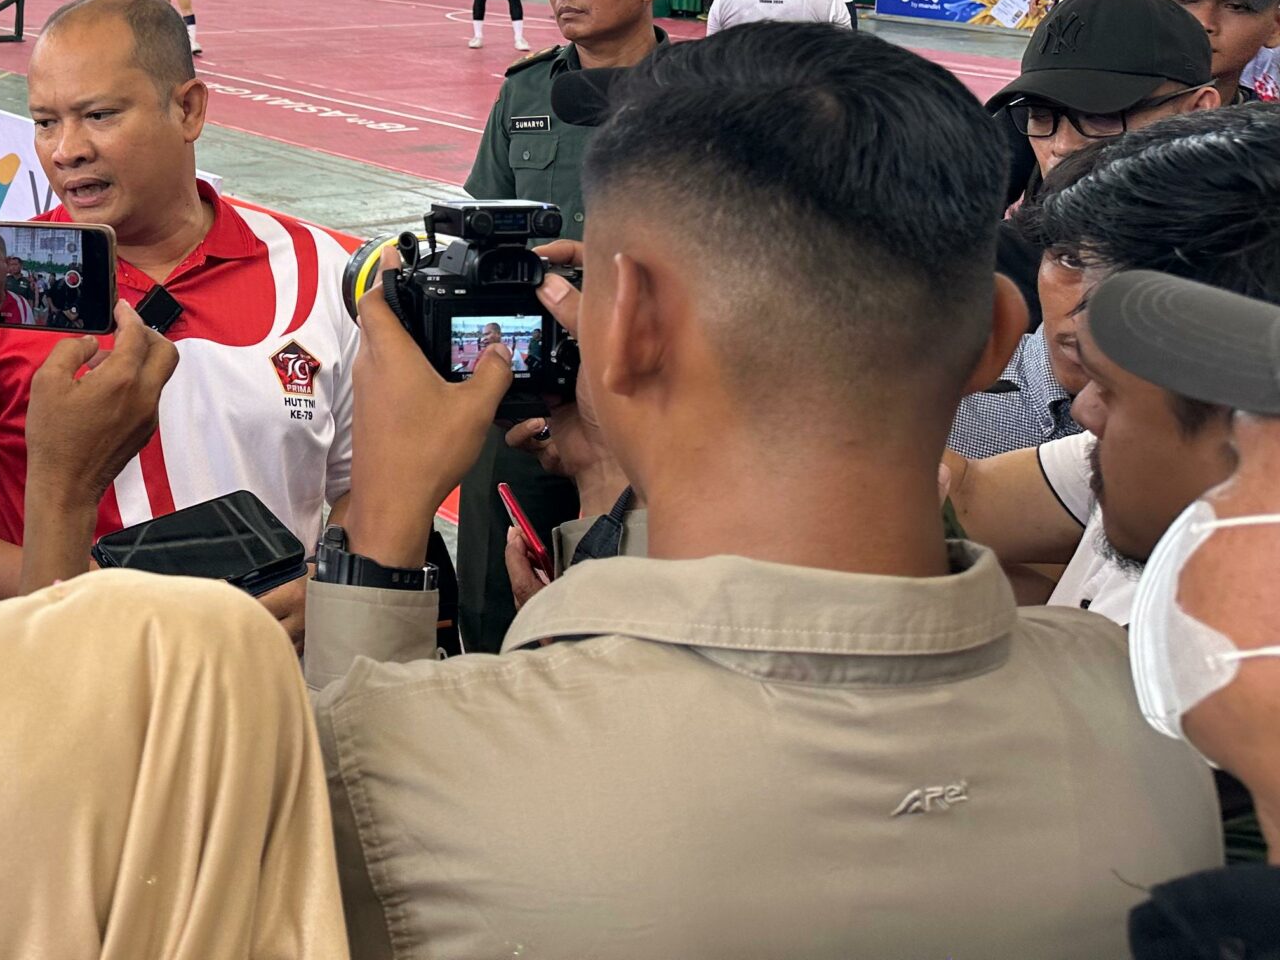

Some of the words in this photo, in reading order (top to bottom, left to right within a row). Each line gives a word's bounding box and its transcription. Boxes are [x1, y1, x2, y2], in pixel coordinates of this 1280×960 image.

[918, 2, 941, 11] mandiri
[1038, 11, 1085, 55] NY
[515, 120, 545, 129] SUNARYO
[278, 352, 309, 385] 79
[286, 384, 312, 394] PRIMA
[284, 397, 302, 408] HUT
[303, 399, 316, 409] TNI
[290, 410, 313, 420] KE-79
